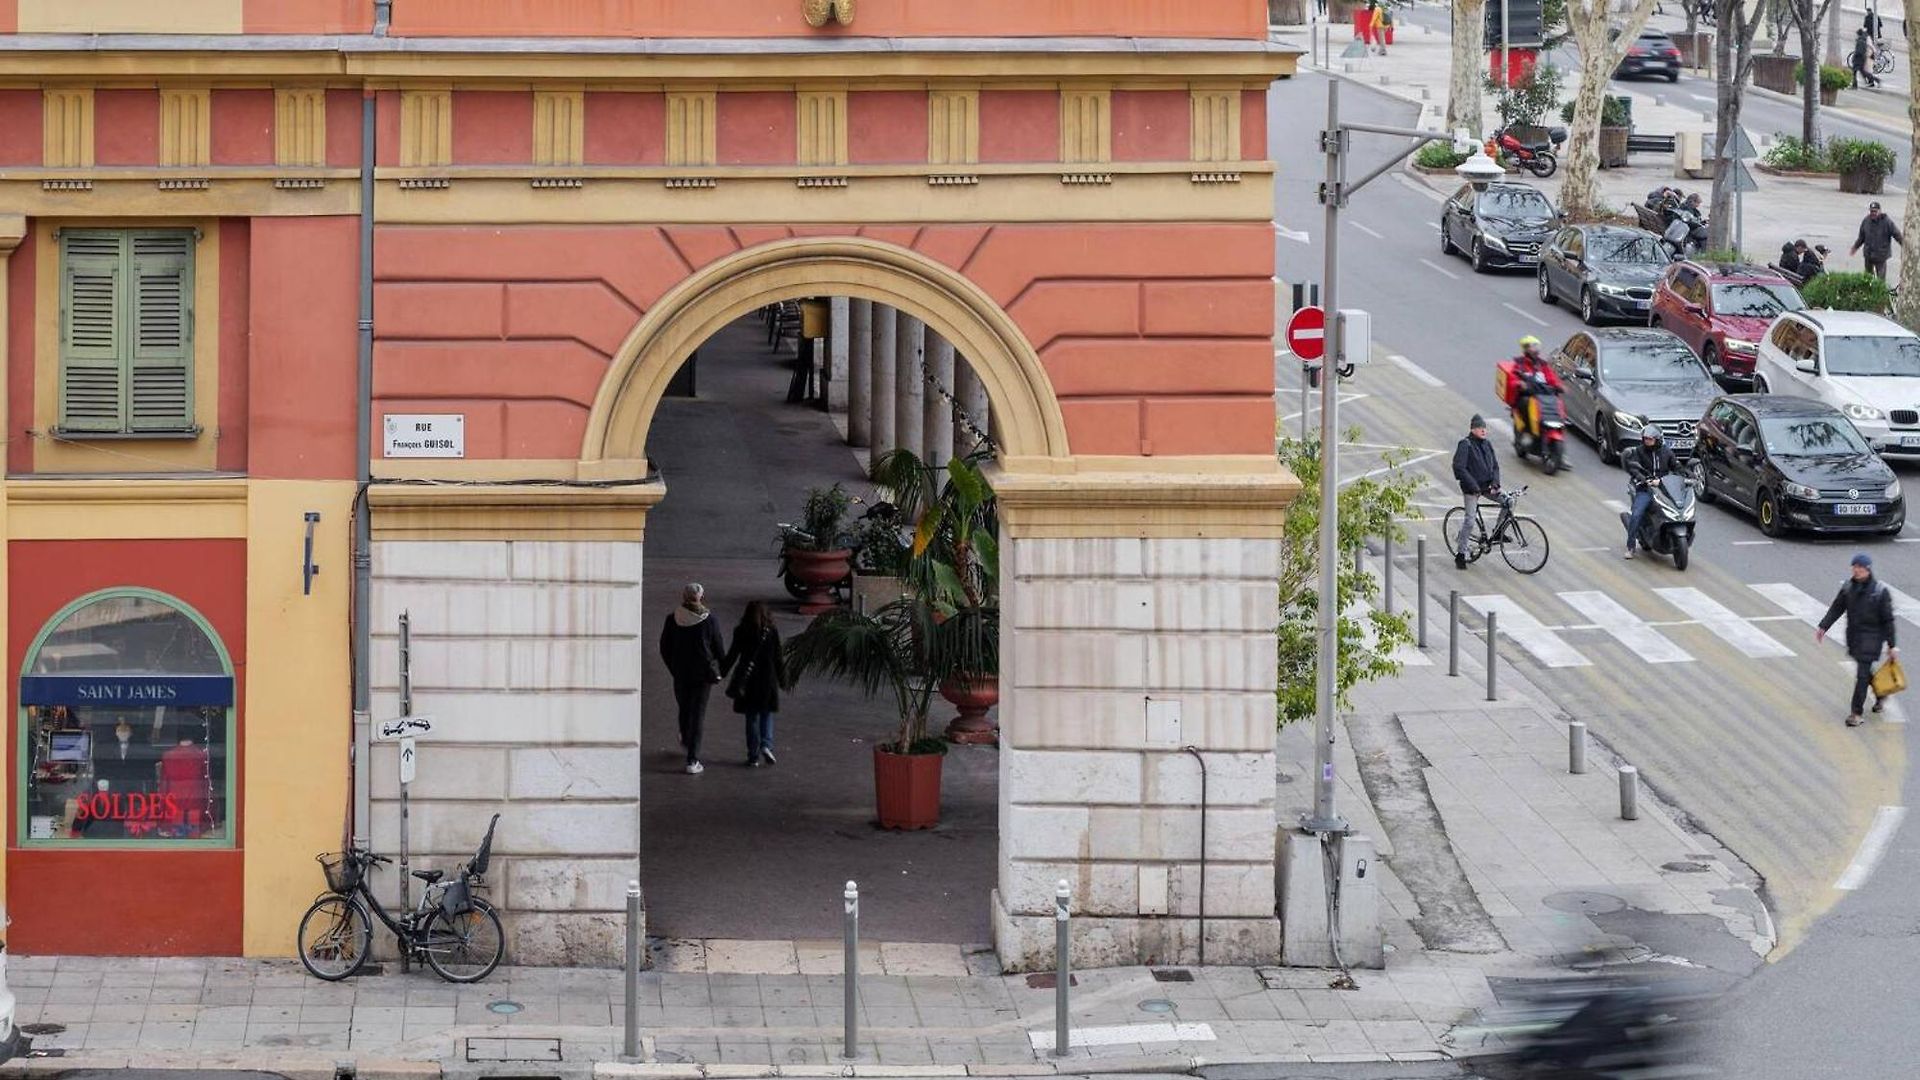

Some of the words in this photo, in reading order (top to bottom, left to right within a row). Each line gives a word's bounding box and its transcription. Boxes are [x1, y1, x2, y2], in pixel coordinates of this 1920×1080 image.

[415, 423, 432, 432] RUE
[424, 439, 455, 449] GUISOL
[78, 685, 124, 699] SAINT
[127, 685, 177, 699] JAMES
[76, 792, 179, 820] SOLDES
